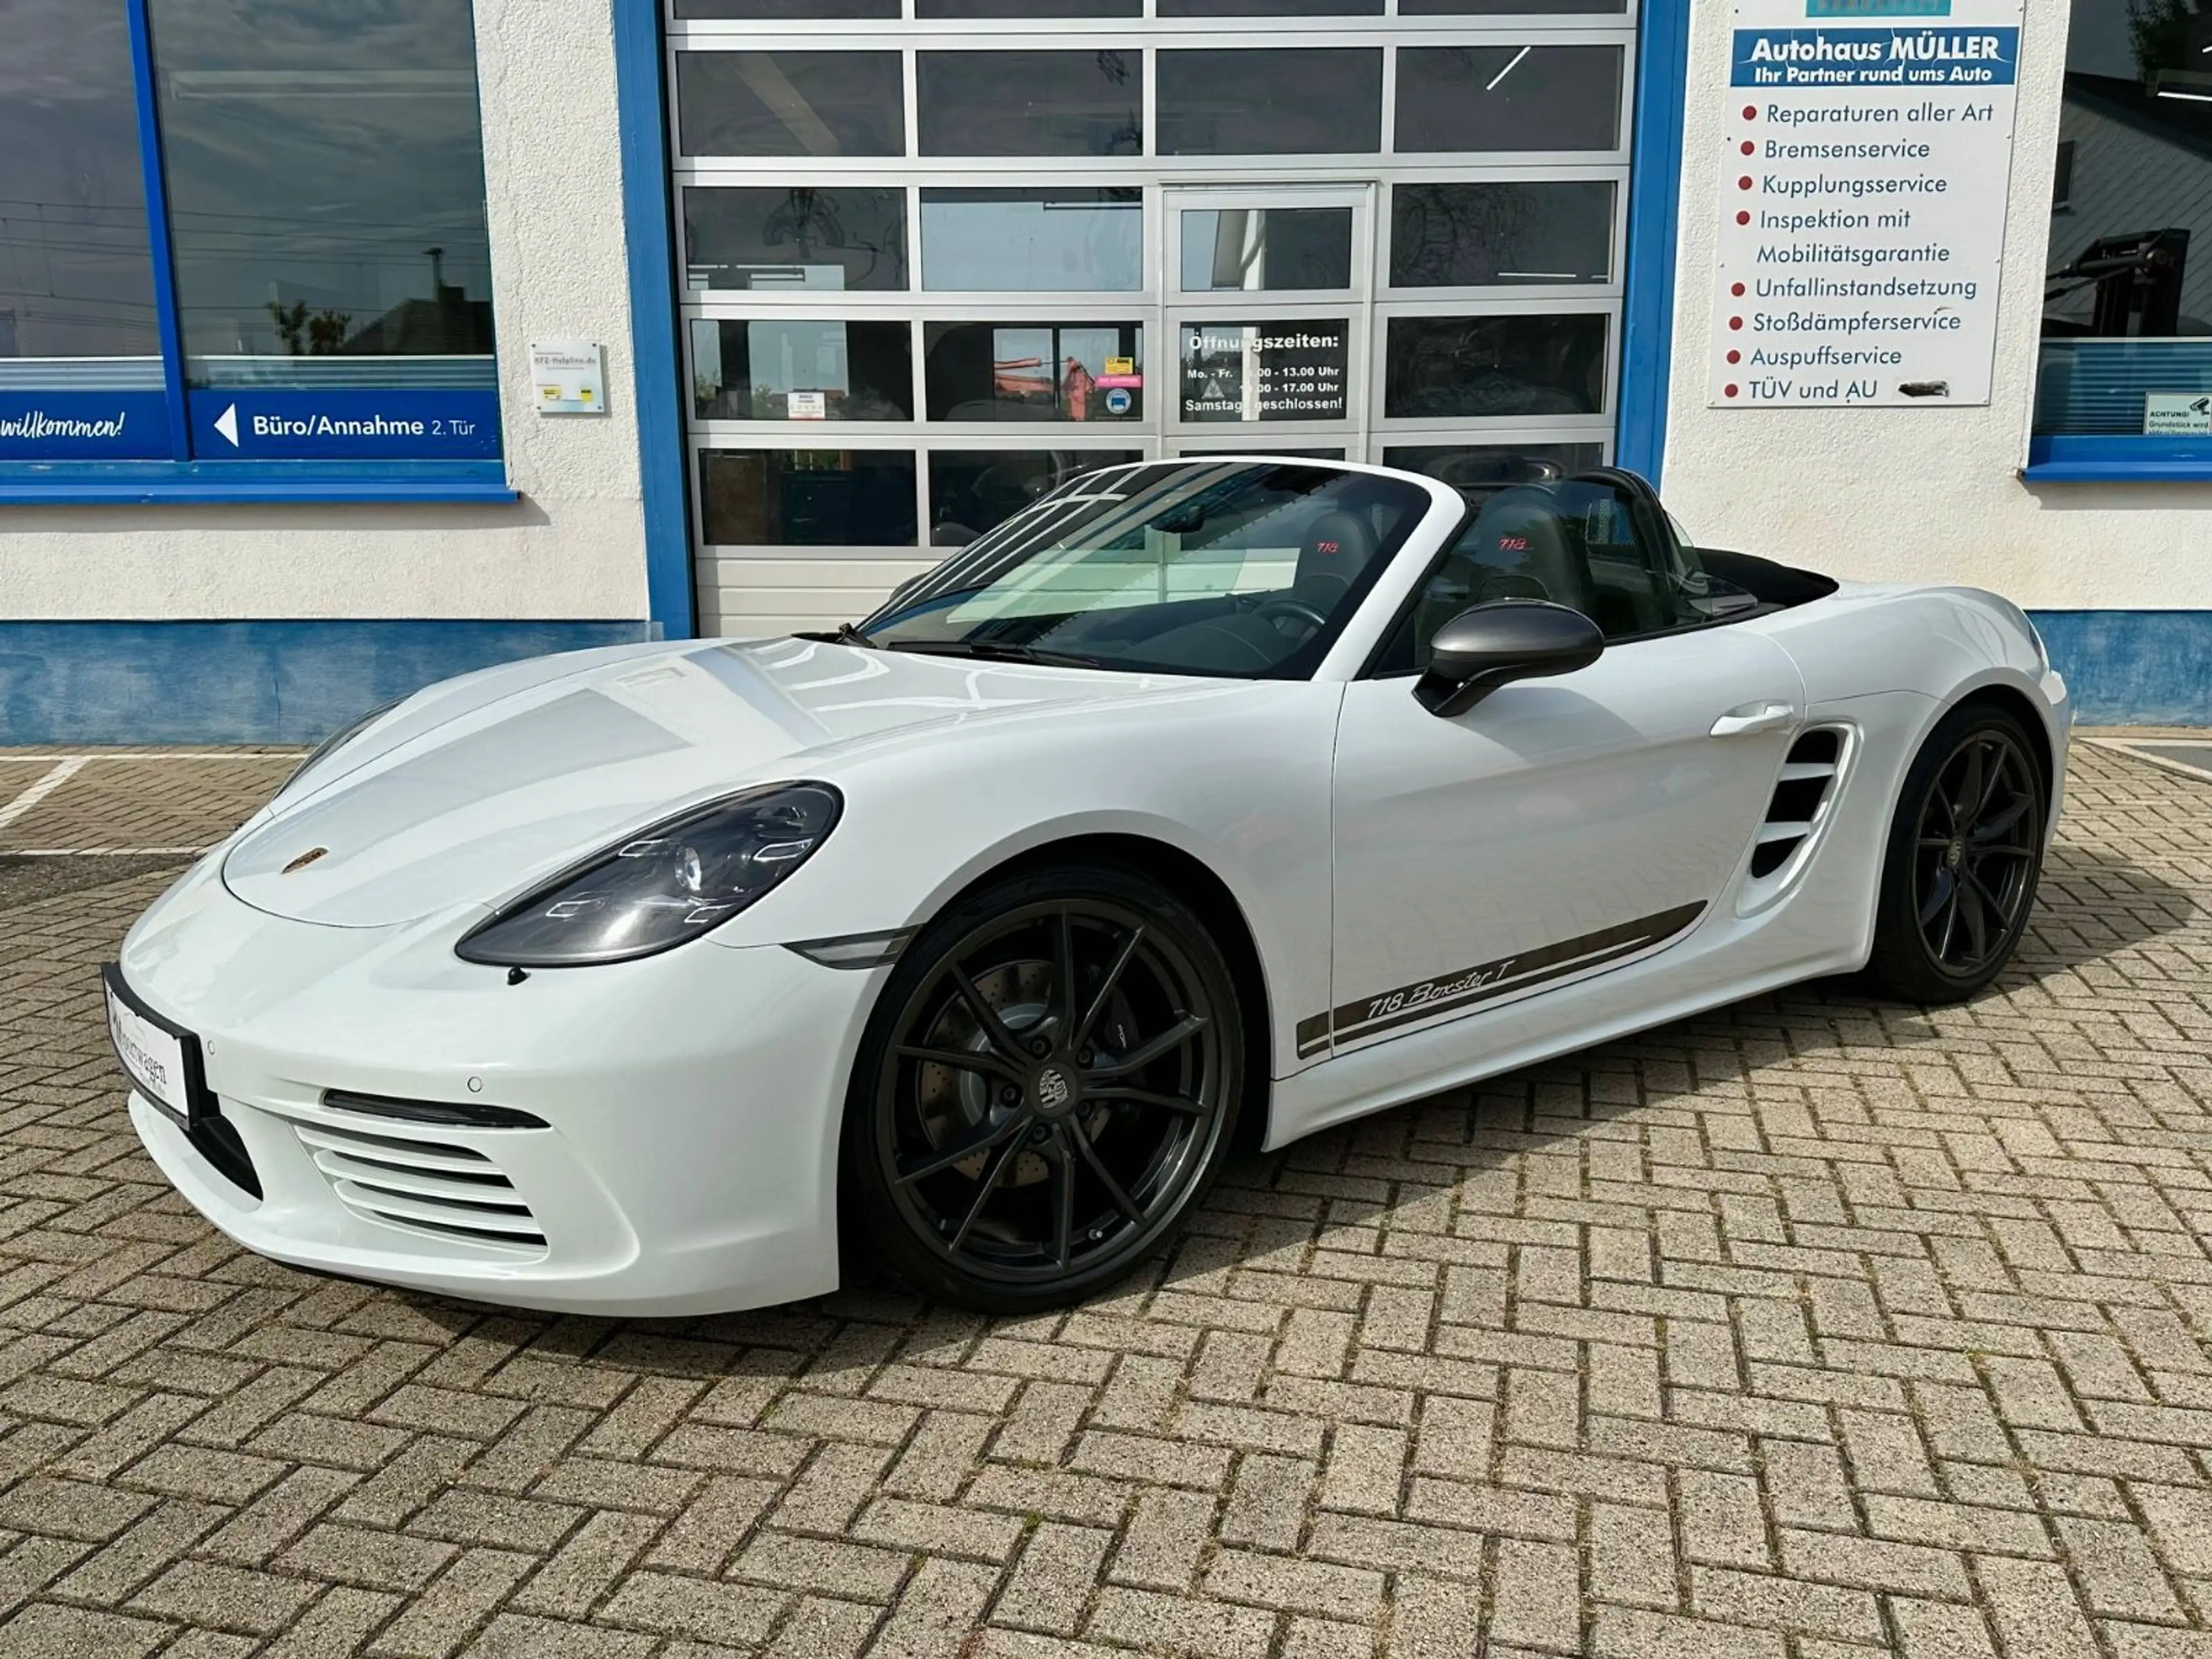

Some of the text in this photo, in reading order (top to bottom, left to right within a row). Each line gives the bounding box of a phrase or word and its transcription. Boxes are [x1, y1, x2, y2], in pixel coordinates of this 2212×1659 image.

[1751, 31, 1999, 61] Autohaus MÜLLER
[1755, 66, 1993, 83] Ihr Partner rund ums Auto
[1766, 102, 1994, 127] Reparaturen aller Art
[1764, 139, 1930, 159] Bremsenservice
[1762, 174, 1948, 198] Kupplungsservice
[1760, 209, 1911, 232] Inspektion mit
[1756, 243, 1950, 267] Mobilitätsgarantie
[1756, 278, 1978, 300] Unfallinstandsetzung
[1752, 311, 1961, 335] Stoßdämpferservice
[1750, 345, 1902, 370] Auspuffservice
[1187, 369, 1208, 379] Mo.
[1218, 369, 1233, 378] Fr.
[1282, 366, 1315, 377] 13.00
[1317, 366, 1339, 376] Uhr
[1282, 382, 1315, 393] 17.00
[1317, 382, 1339, 392] Uhr
[1748, 376, 1878, 399] TÜV und AU
[1185, 396, 1343, 414] Samstag geschlossen!
[1, 410, 126, 440] willkommen!
[252, 414, 476, 436] Büro/Annahme 2. Tür
[1316, 542, 1338, 553] 718
[1499, 537, 1527, 551] 718
[1367, 959, 1516, 1019] 718 Boxster T
